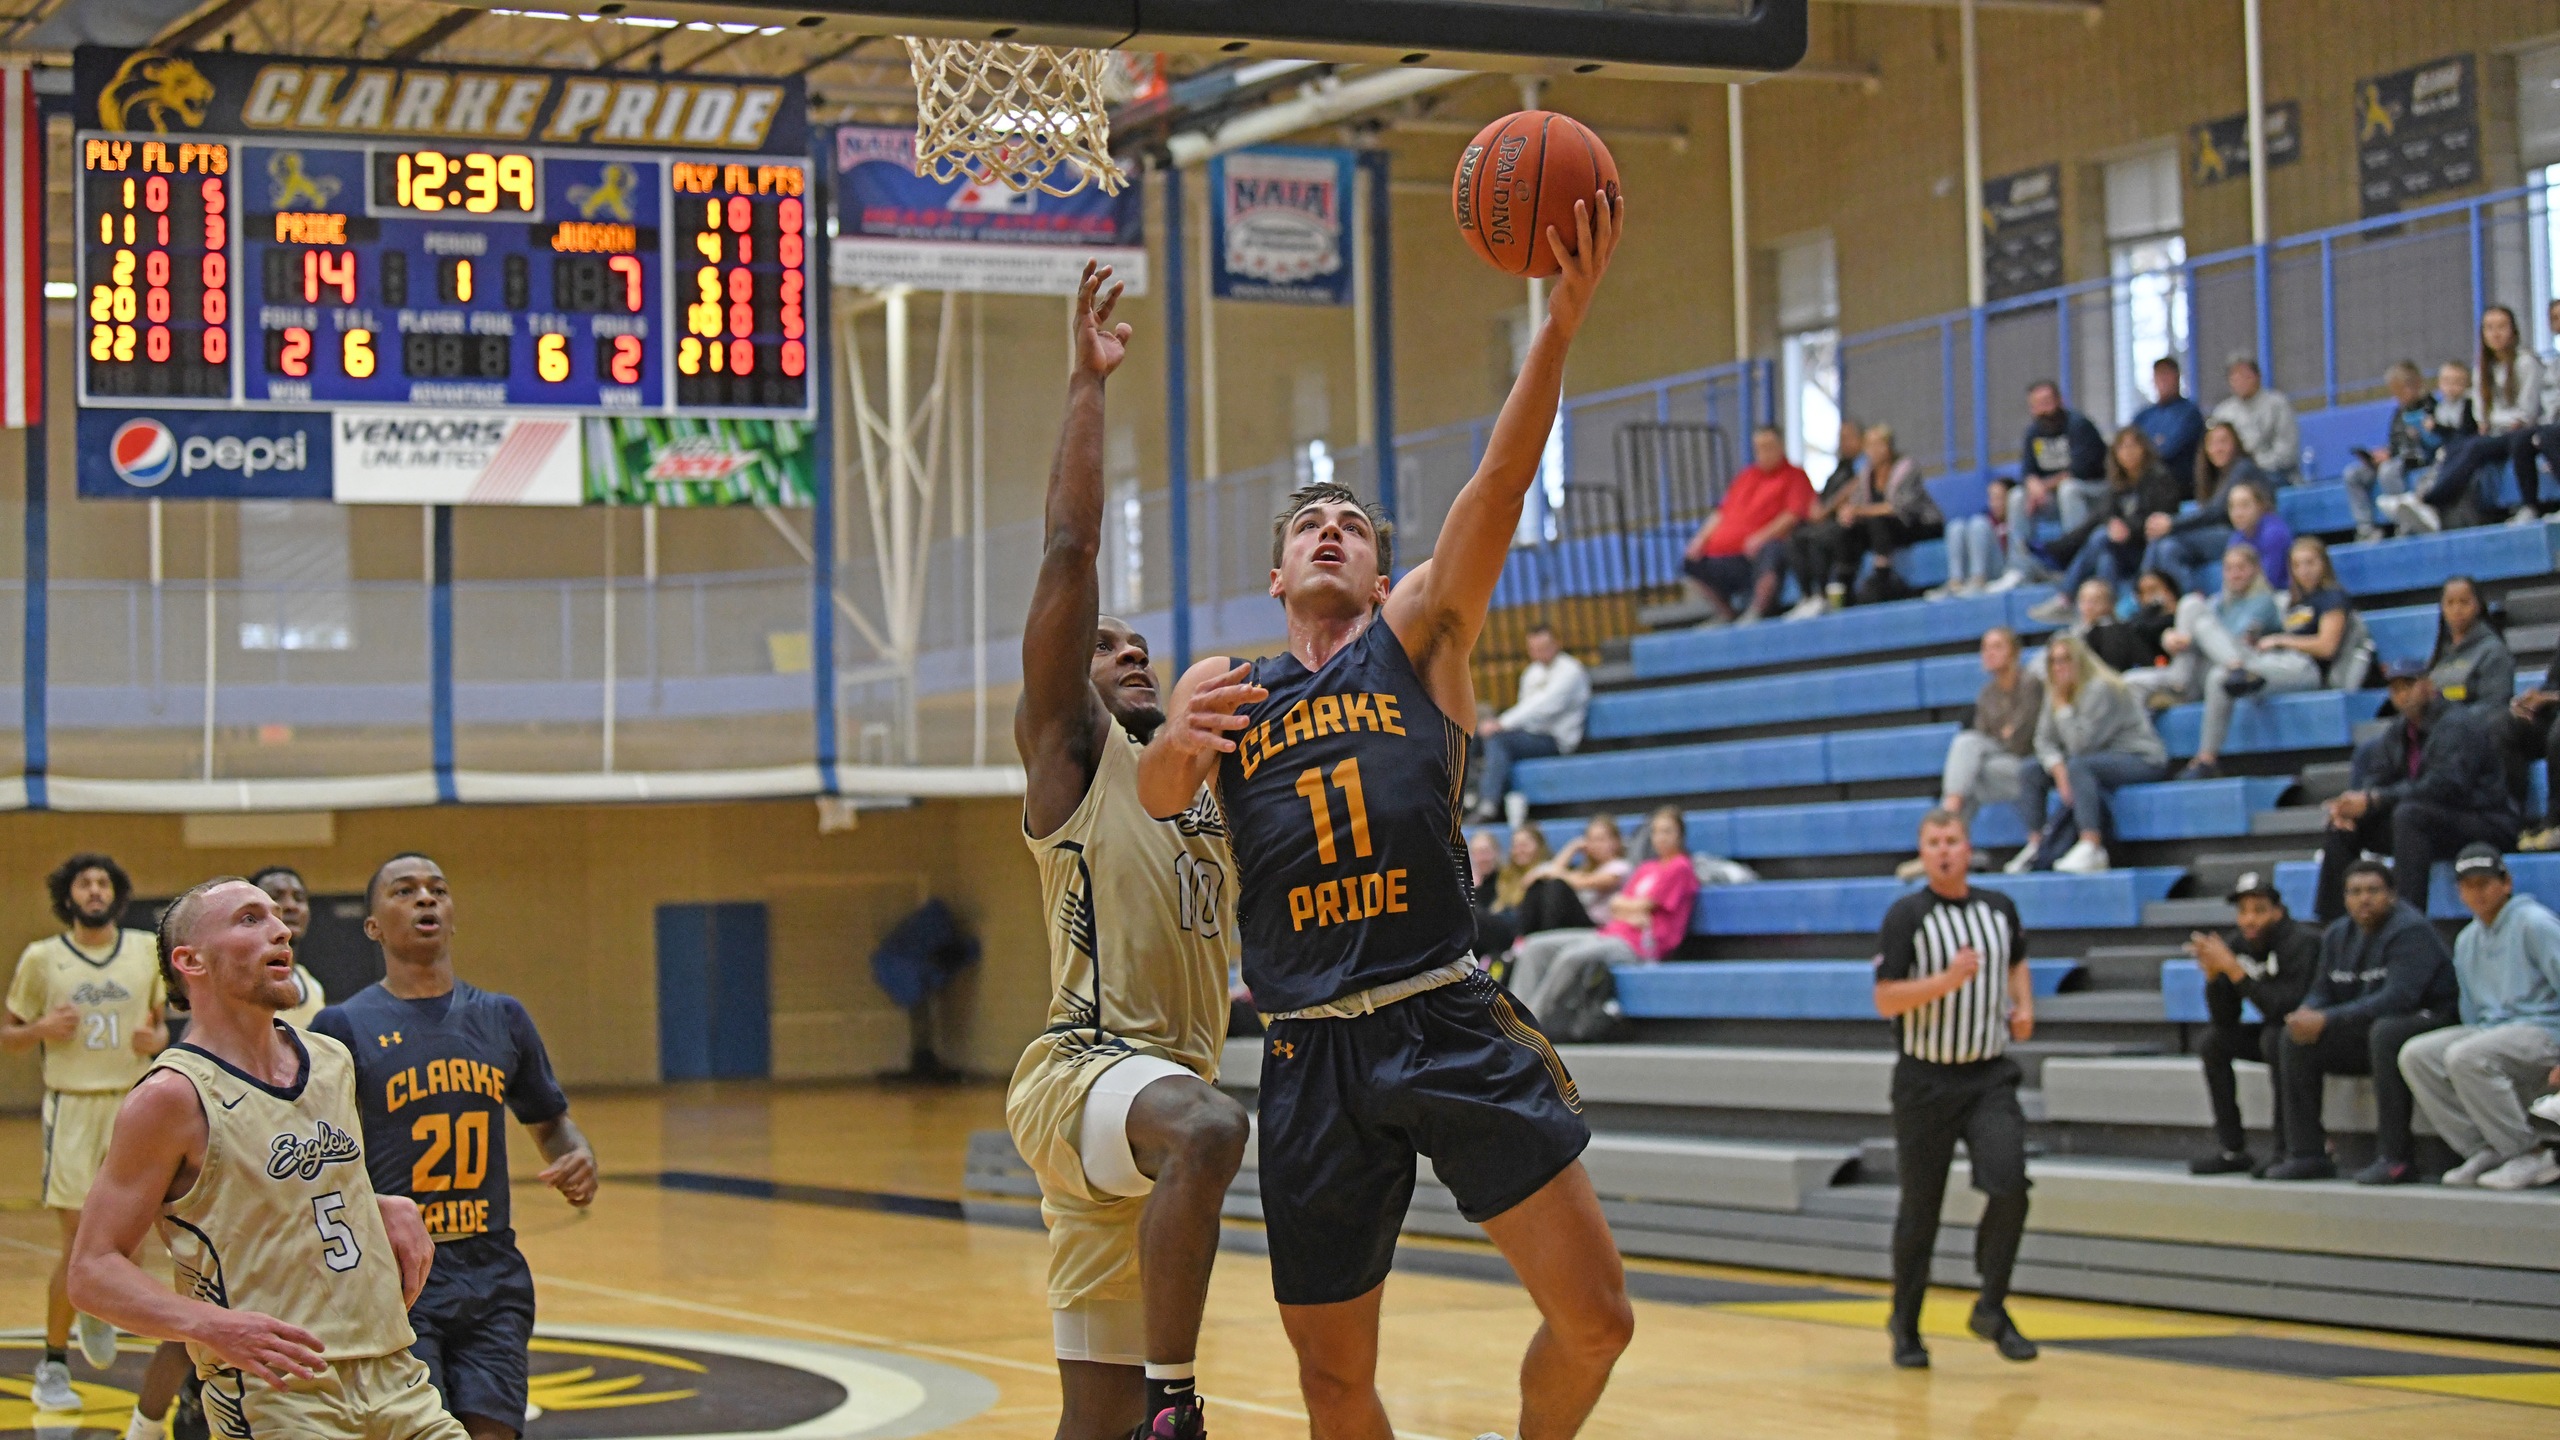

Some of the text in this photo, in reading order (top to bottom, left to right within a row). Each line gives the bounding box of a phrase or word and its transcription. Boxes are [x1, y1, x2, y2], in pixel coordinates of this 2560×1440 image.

[244, 64, 783, 150] CLARKE PRIDE
[179, 143, 228, 175] PTS
[397, 151, 534, 213] 12:39
[123, 176, 225, 214] 1 0 5
[1235, 178, 1325, 219] NAIA
[1457, 145, 1484, 230] NAIA
[1492, 134, 1529, 245] SPALDING
[101, 213, 226, 250] 11 1 3
[112, 249, 226, 289] 2 0 0
[304, 250, 355, 303] 14
[456, 259, 472, 302] 1
[609, 256, 641, 312] 7
[90, 285, 226, 324] 20 0 0
[90, 324, 227, 363] 22 0 0
[281, 327, 311, 376] 2
[344, 329, 375, 377] 6
[538, 333, 569, 382] 6
[612, 335, 641, 384] 2
[182, 430, 306, 478] pepsi
[343, 419, 506, 445] VENDORS
[360, 450, 491, 469] UNLIMITED
[1238, 692, 1407, 781] CLARKE
[1295, 756, 1373, 865] 11
[1174, 850, 1224, 939] 10
[1287, 868, 1409, 932] PRIDE
[84, 1012, 119, 1050] 21
[385, 1057, 506, 1113] CLARKE
[267, 1120, 361, 1181] Eagles
[411, 1110, 489, 1193] 20
[311, 1190, 362, 1273] 5
